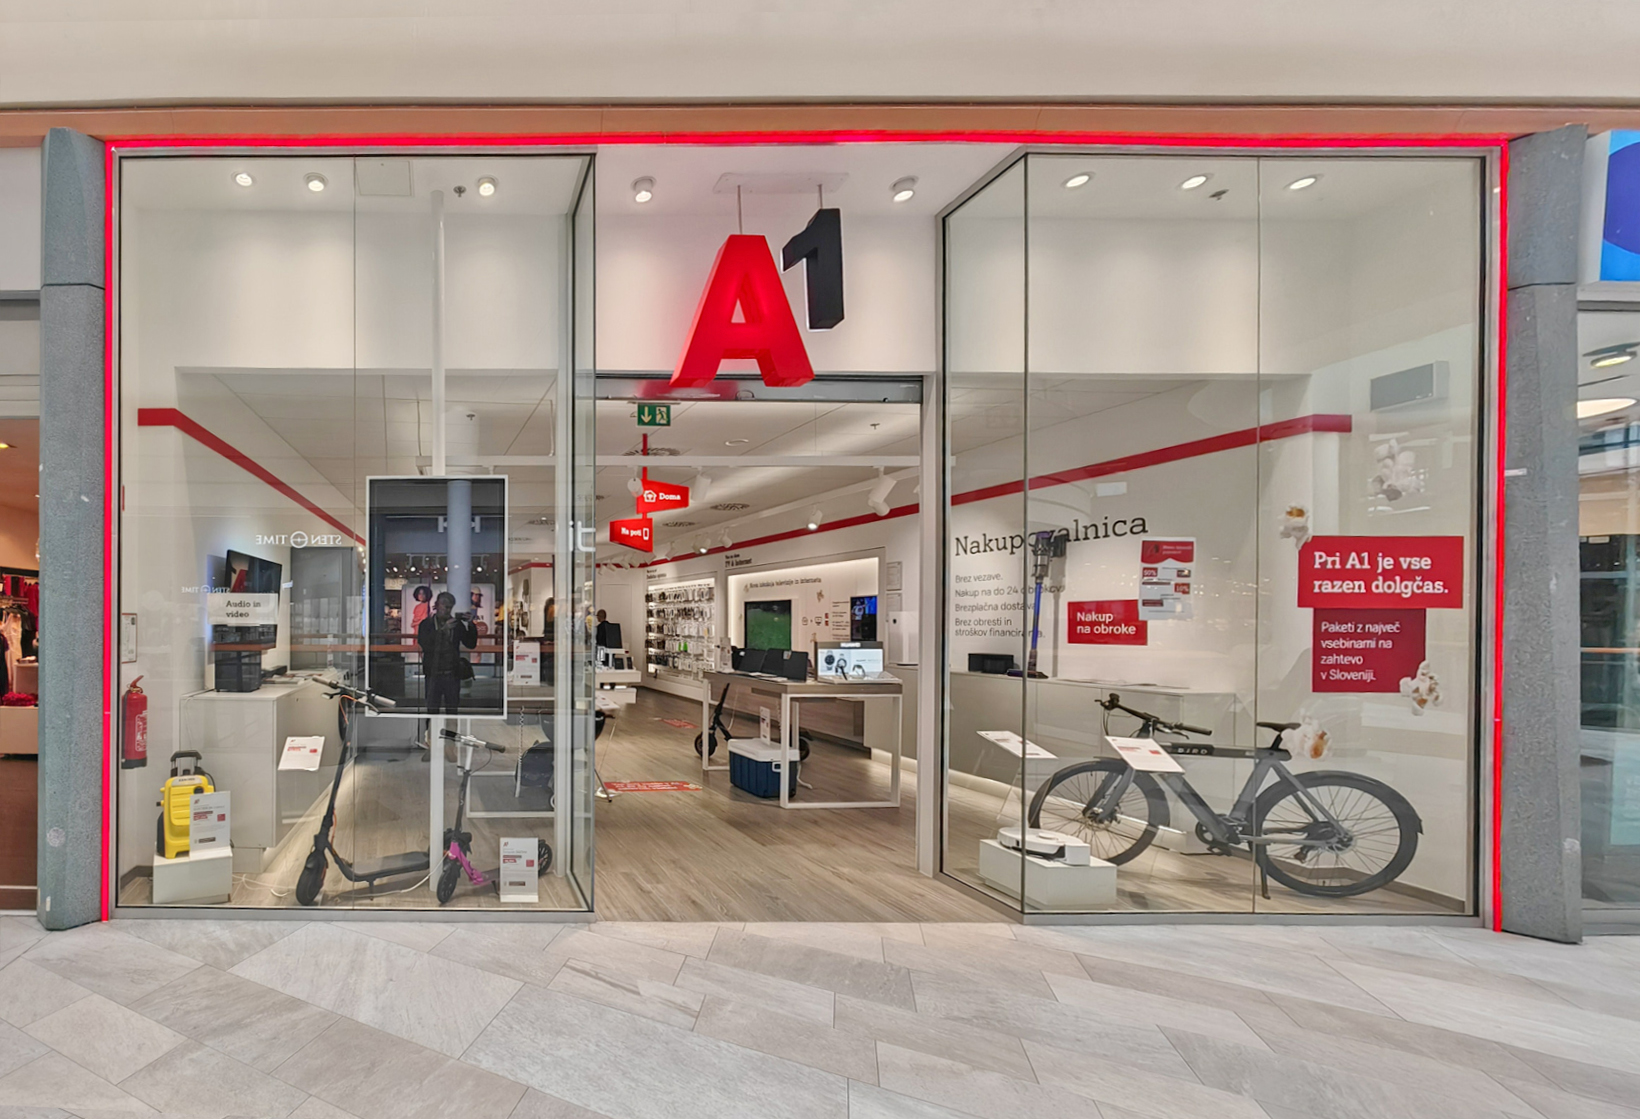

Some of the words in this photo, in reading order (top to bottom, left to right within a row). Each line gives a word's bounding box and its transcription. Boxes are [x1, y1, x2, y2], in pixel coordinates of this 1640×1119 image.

[669, 208, 844, 388] A1
[658, 492, 681, 500] Doma
[1313, 551, 1341, 569] Pri
[1345, 551, 1371, 569] A1
[1376, 552, 1394, 573] je
[1399, 556, 1432, 570] vse
[955, 574, 972, 583] Brez
[955, 588, 980, 598] Nakup
[981, 588, 992, 596] na
[994, 587, 1005, 596] do
[1007, 585, 1019, 595] 24
[1313, 579, 1367, 594] razen
[1371, 576, 1449, 598] dolgčas.
[226, 600, 251, 608] Audio
[253, 600, 261, 608] in
[955, 617, 972, 627] Brez
[973, 616, 1002, 627] obresti
[1004, 616, 1013, 626] in
[1076, 611, 1114, 624] Nakup
[955, 628, 988, 637] stroškov
[1077, 625, 1091, 634] na
[1093, 623, 1137, 635] obroke
[1321, 621, 1355, 634] Paketi
[1356, 624, 1363, 633] z
[1365, 621, 1401, 636] največ
[1321, 637, 1376, 649] vsebinami
[1378, 640, 1393, 649] na
[1320, 653, 1364, 666] zahtevo
[1320, 672, 1328, 681] v
